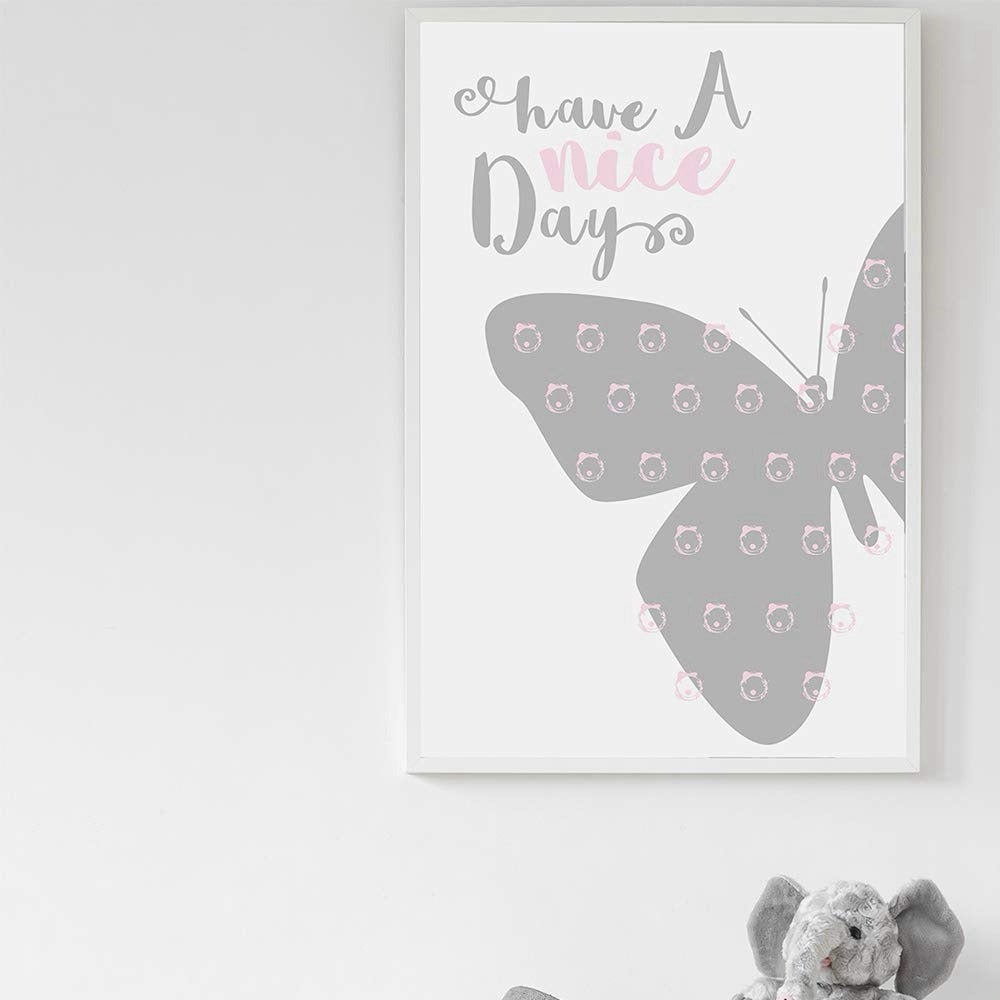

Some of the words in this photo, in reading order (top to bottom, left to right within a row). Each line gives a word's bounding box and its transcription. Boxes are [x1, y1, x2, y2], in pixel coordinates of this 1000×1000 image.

[454, 76, 657, 134] have
[674, 50, 752, 141] A
[540, 131, 735, 196] nice
[472, 152, 695, 281] Day
